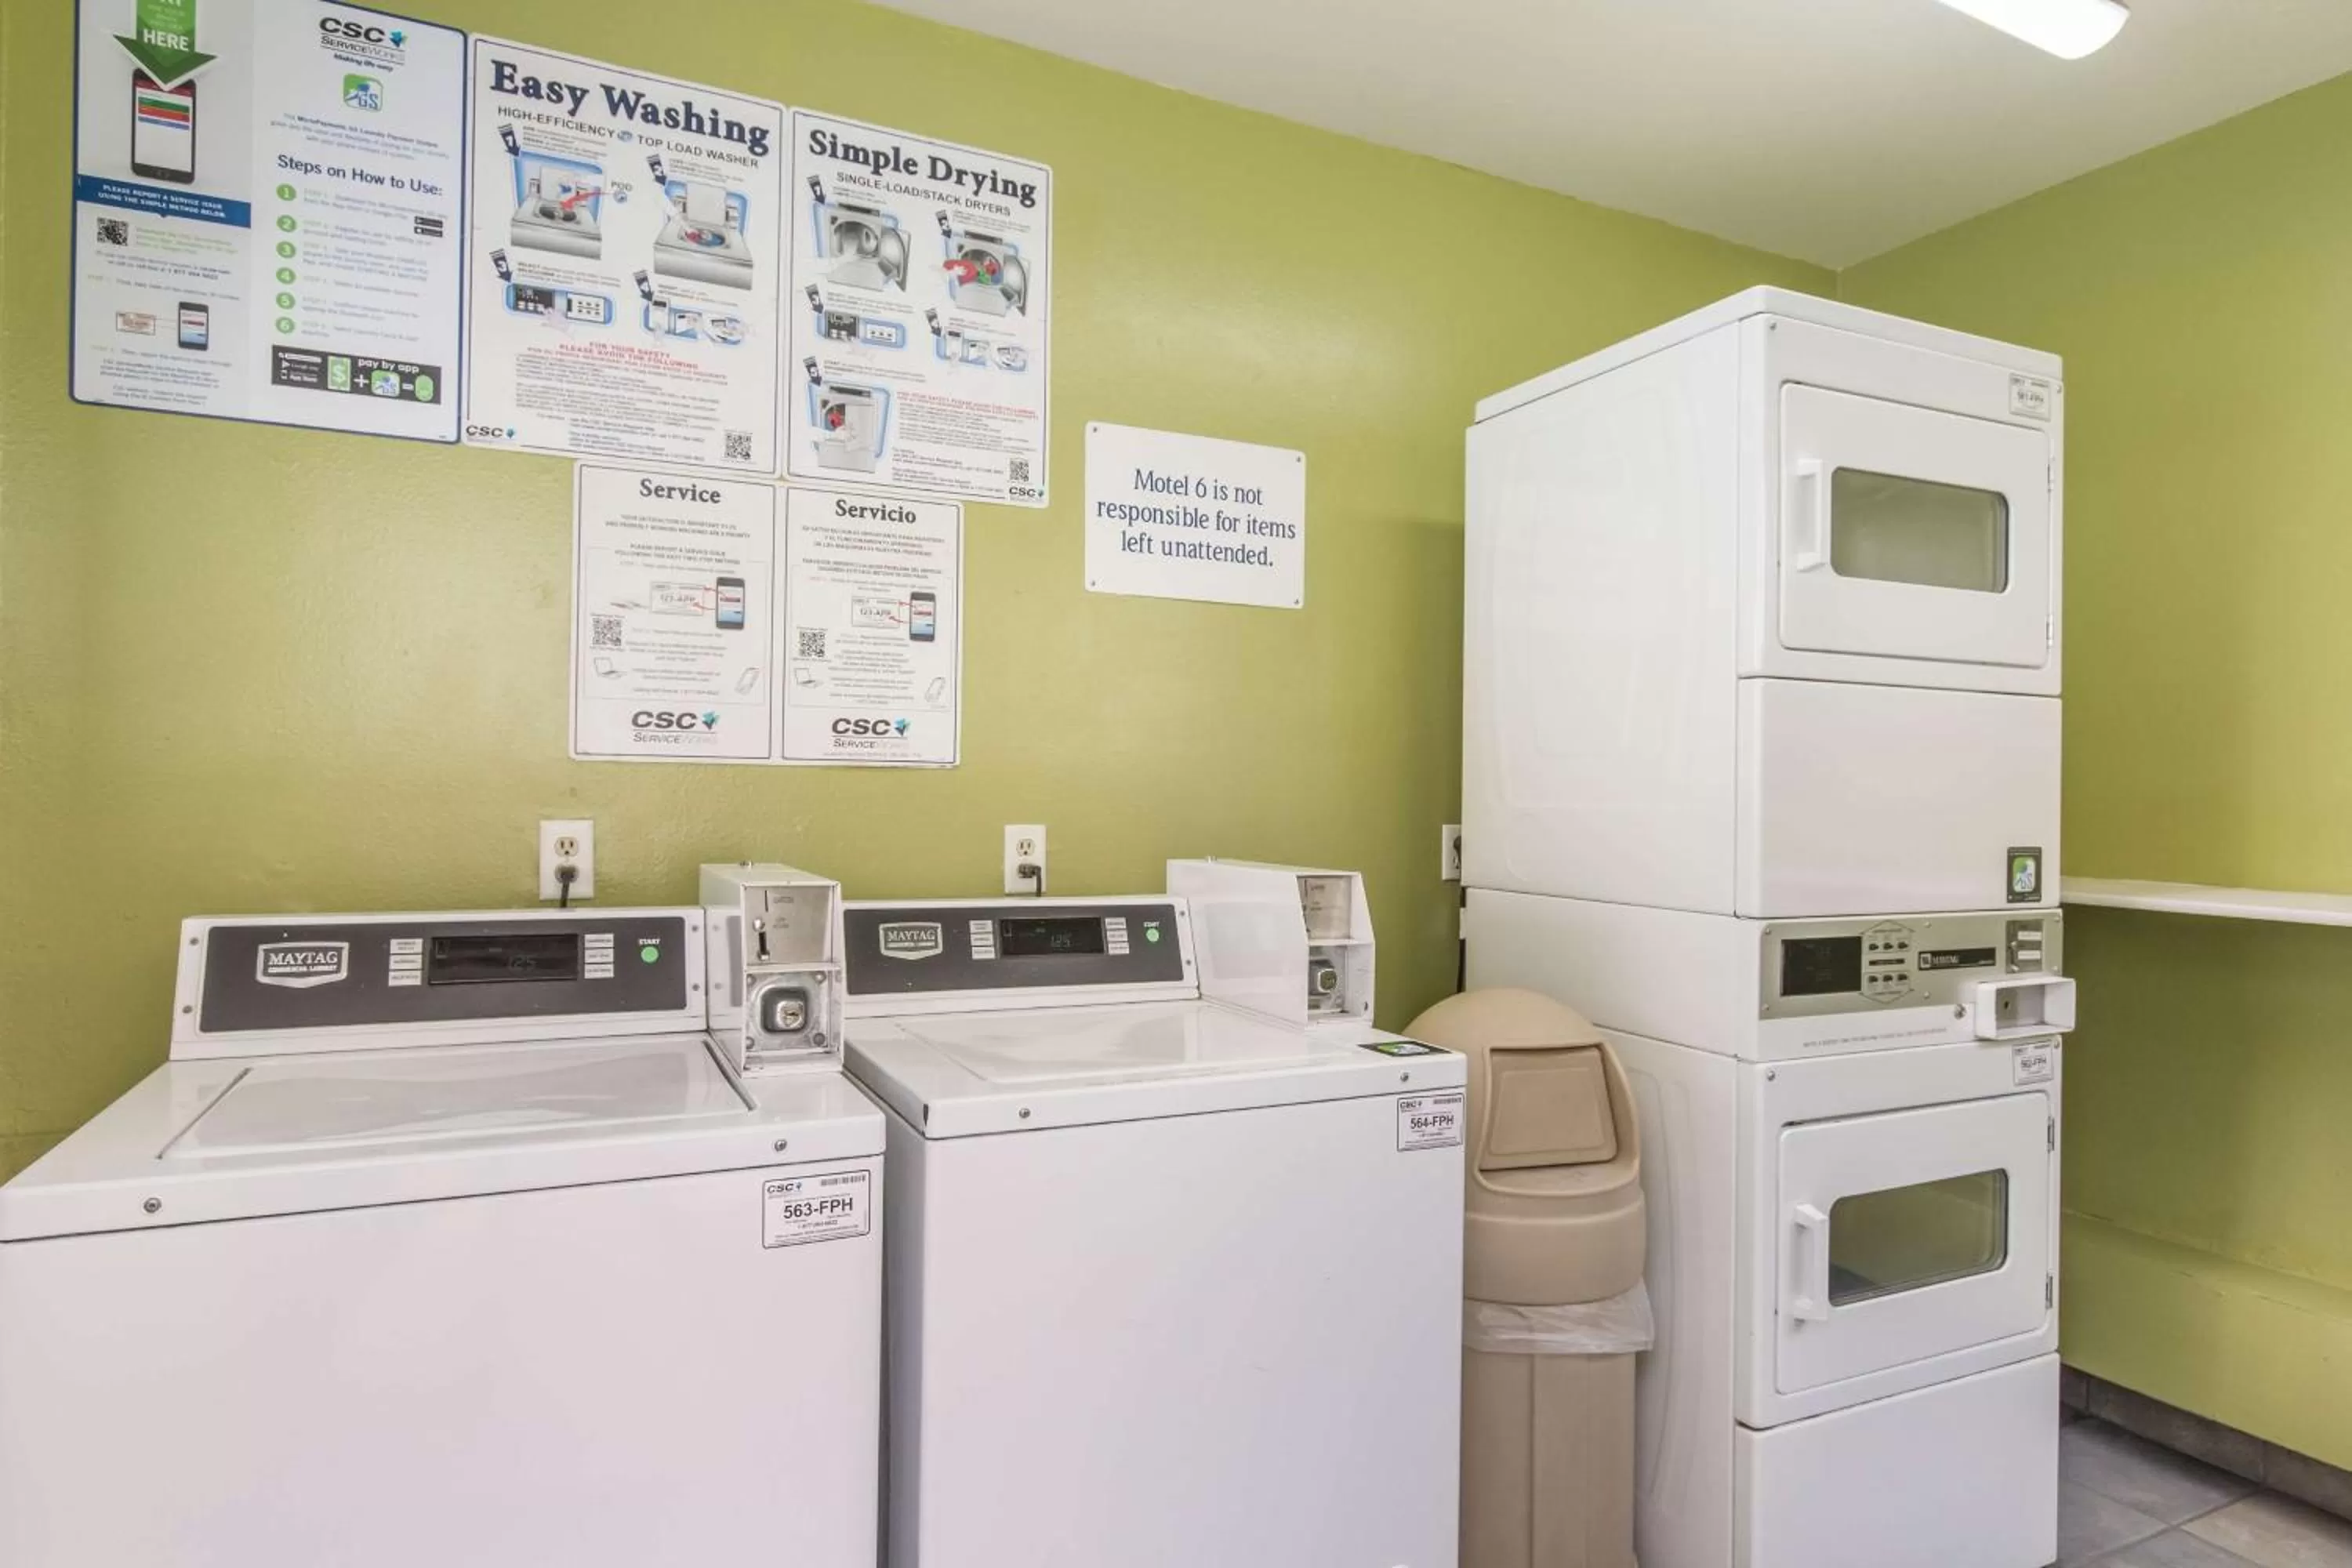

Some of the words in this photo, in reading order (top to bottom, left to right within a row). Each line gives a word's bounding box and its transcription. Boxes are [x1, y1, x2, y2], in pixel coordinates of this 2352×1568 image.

[143, 28, 189, 52] HERE
[320, 17, 385, 42] CSC
[490, 60, 590, 117] Easy
[600, 83, 770, 158] Washing
[497, 104, 617, 139] HIGH-EFFICIENCY
[637, 136, 663, 147] TOP
[667, 141, 702, 156] LOAD
[706, 150, 760, 169] WASHER
[278, 154, 322, 175] Steps
[327, 167, 346, 180] on
[352, 167, 385, 186] How
[390, 175, 405, 189] to
[410, 178, 444, 196] Use:
[809, 129, 919, 176] Simple
[927, 155, 1036, 209] Drying
[965, 199, 1011, 216] DRYERS
[358, 358, 379, 368] pay
[382, 360, 394, 371] by
[398, 365, 419, 375] app
[466, 425, 503, 437] CSC
[640, 478, 721, 503] Service
[1009, 486, 1036, 497] CSC
[1134, 468, 1189, 496] Motel
[1195, 477, 1207, 498] 6
[1214, 479, 1229, 501] is
[1234, 486, 1263, 506] not
[835, 499, 916, 524] Servicio
[1097, 500, 1210, 529] responsible
[1215, 510, 1240, 532] for
[1247, 514, 1297, 539] items
[1121, 530, 1153, 554] left
[1161, 539, 1274, 568] unattended.
[632, 711, 697, 729] CSC
[832, 718, 891, 735] CSC
[887, 929, 935, 941] MAYTAG
[268, 951, 339, 965] MAYTAG
[1410, 1114, 1454, 1130] 564-FPH
[767, 1182, 794, 1193] CSC
[783, 1197, 853, 1219] 563-FPH
